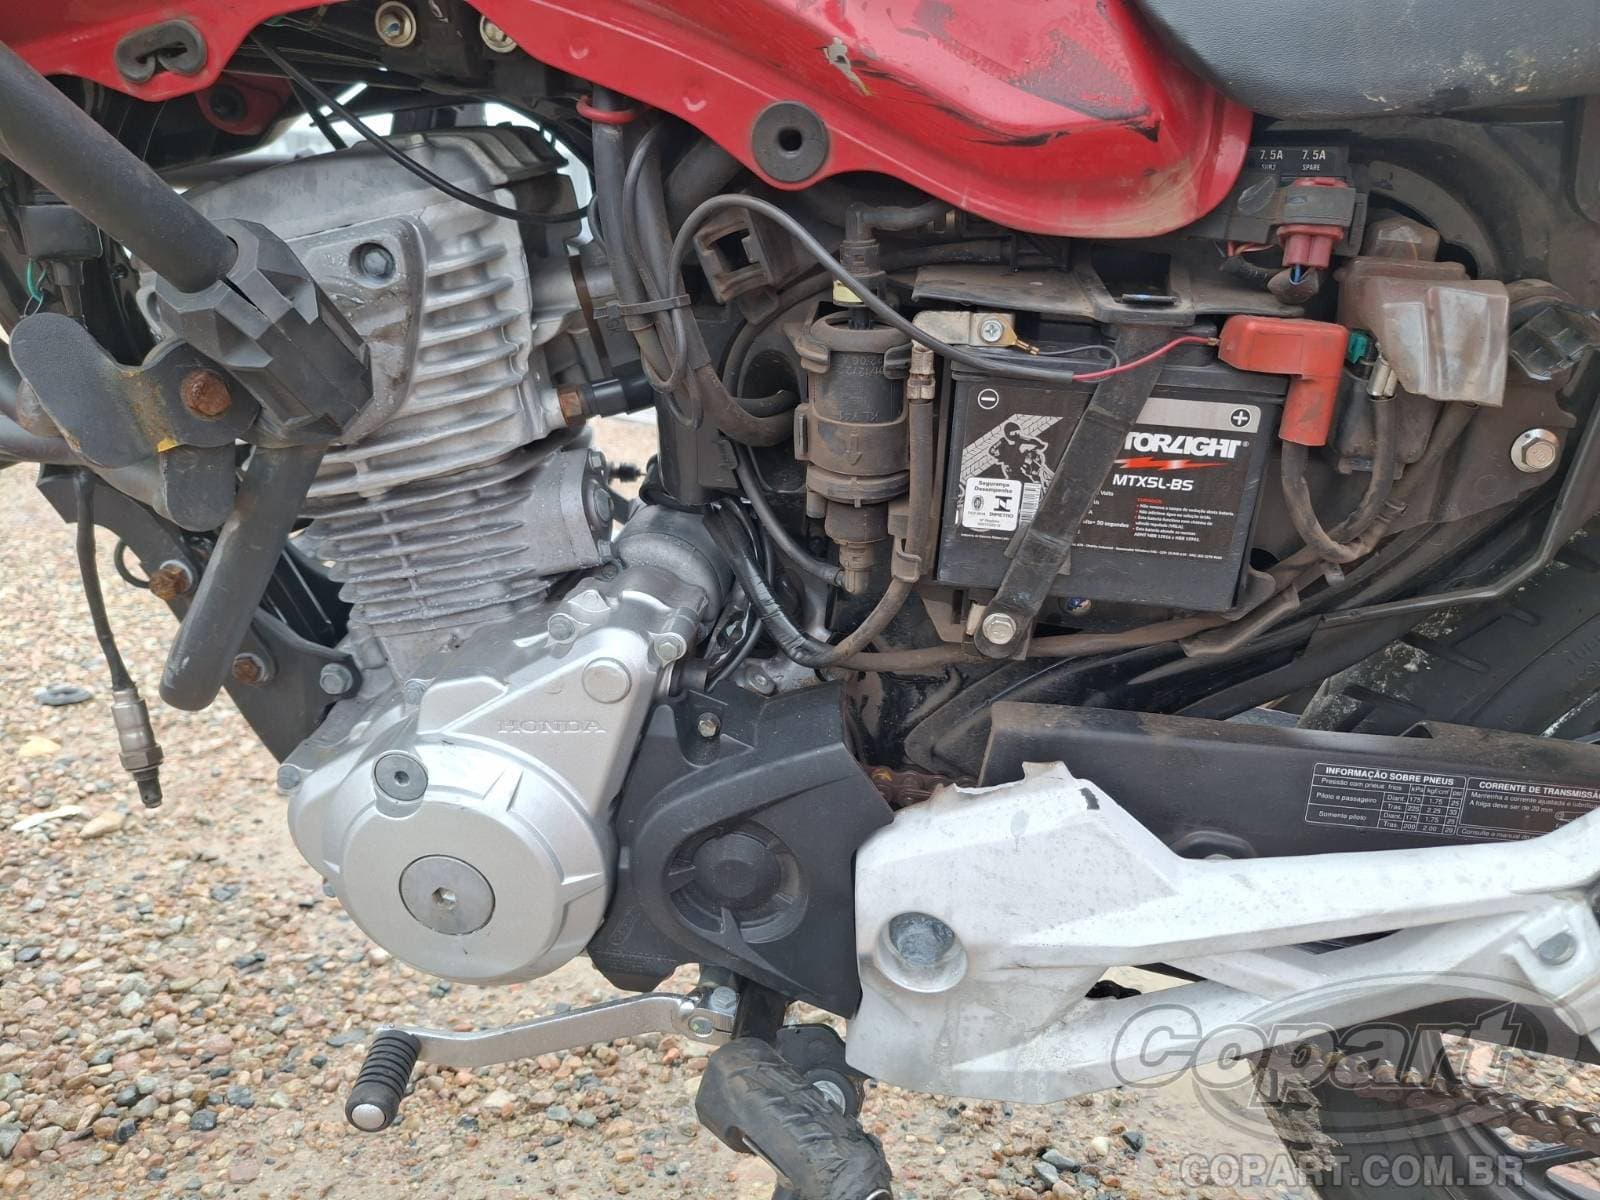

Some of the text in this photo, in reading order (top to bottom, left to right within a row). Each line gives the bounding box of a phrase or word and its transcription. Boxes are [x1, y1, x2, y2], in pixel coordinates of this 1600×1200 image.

[1302, 163, 1321, 171] SPARE
[1124, 431, 1241, 459] TORLIGHT
[1112, 473, 1194, 491] MTX5L-BS
[497, 719, 606, 734] HONDA
[1326, 766, 1454, 785] INFORMAÇÃO SOBRE PNEUS
[1479, 781, 1600, 800] CORRENTE DE TRANSMISSÃ
